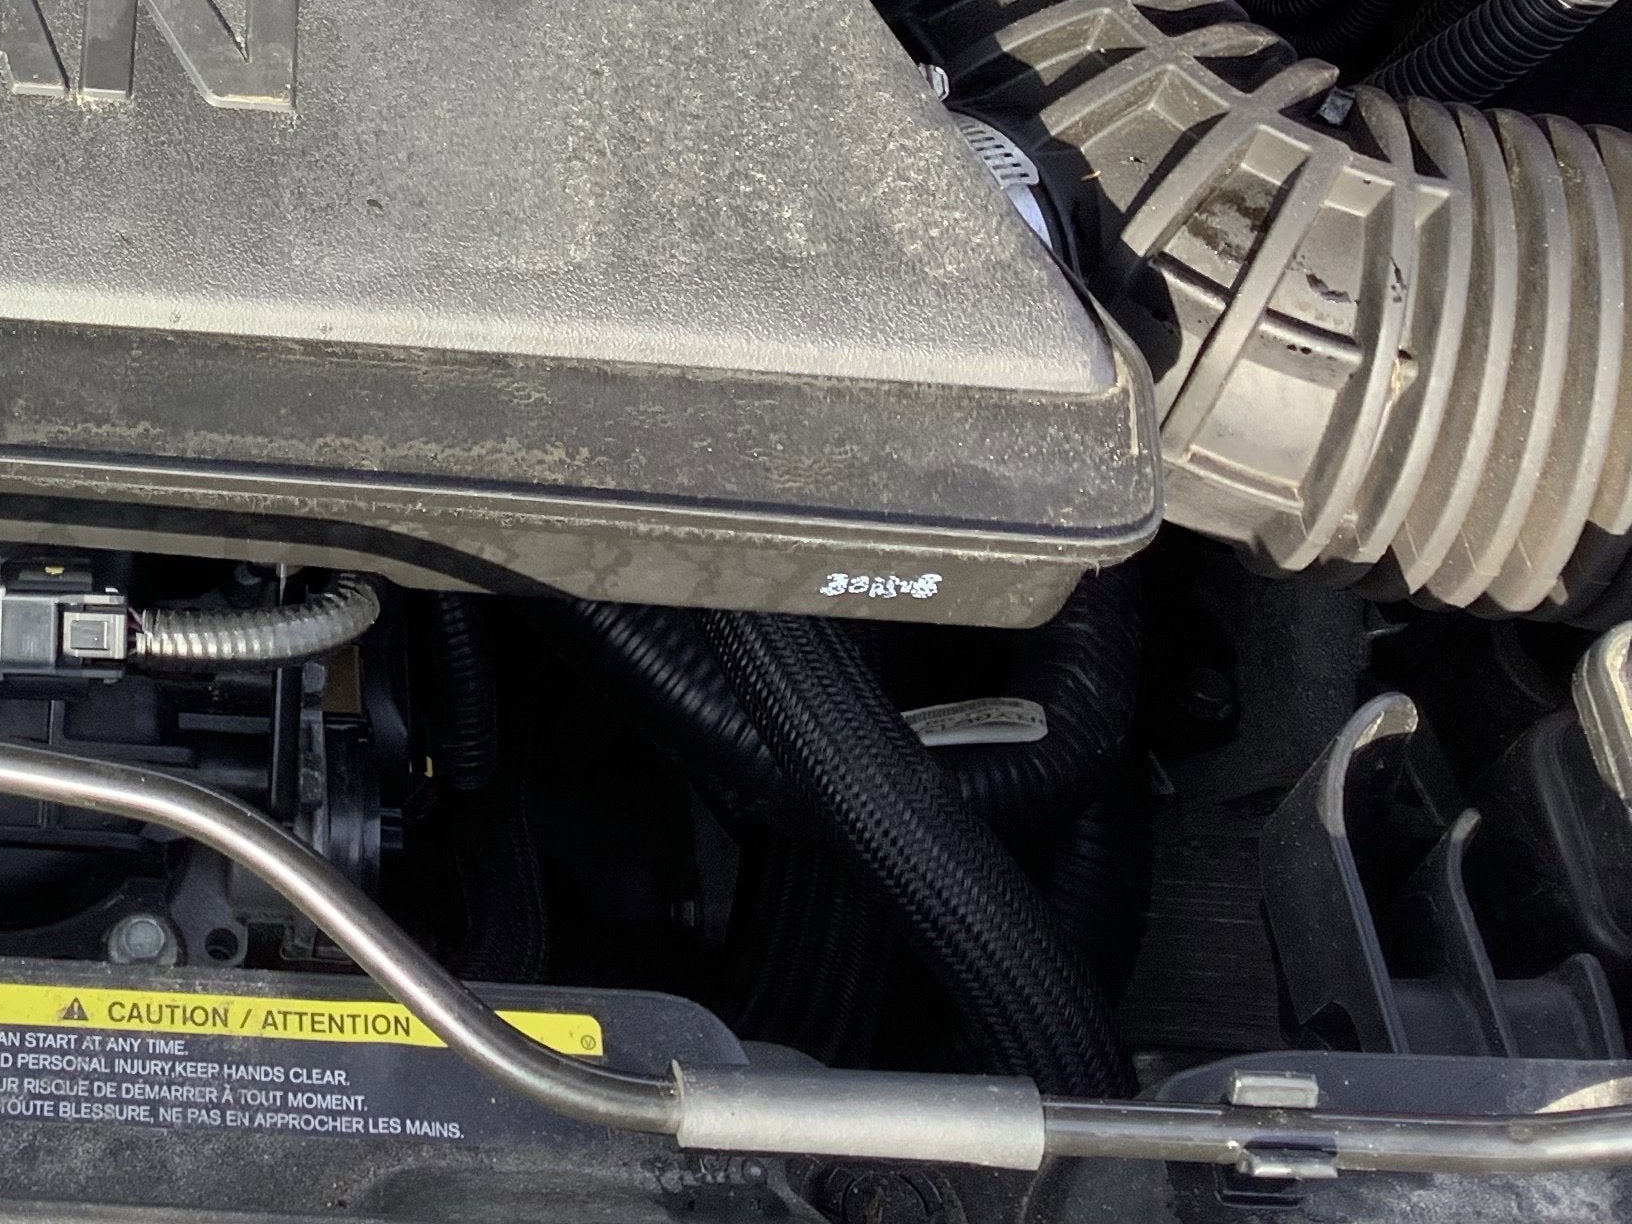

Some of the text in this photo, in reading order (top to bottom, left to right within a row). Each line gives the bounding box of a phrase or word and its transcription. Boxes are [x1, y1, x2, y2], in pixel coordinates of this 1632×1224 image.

[108, 1001, 411, 1037] CAUTION / ATTENTION
[25, 1033, 78, 1050] START
[81, 1036, 102, 1051] AT
[106, 1037, 141, 1053] ANY
[146, 1038, 189, 1056] TIME.
[18, 1054, 110, 1073] PERSONAL
[223, 1064, 285, 1082] HANDS
[289, 1067, 351, 1086] CLEAR.
[24, 1078, 89, 1097] RISQUE
[93, 1081, 117, 1097] DE
[121, 1078, 218, 1103] DÉMARRER
[221, 1084, 234, 1103] À
[240, 1089, 284, 1107] TOUT
[288, 1092, 368, 1112] MOMENT.
[0, 1097, 55, 1117] TOUTE
[59, 1101, 155, 1123] BLESSURE,
[159, 1108, 183, 1123] NE
[187, 1108, 221, 1126] PAS
[226, 1111, 249, 1127] EN
[254, 1112, 364, 1134] APPROCHER
[369, 1118, 401, 1134] LES
[406, 1120, 465, 1140] MAINS.
